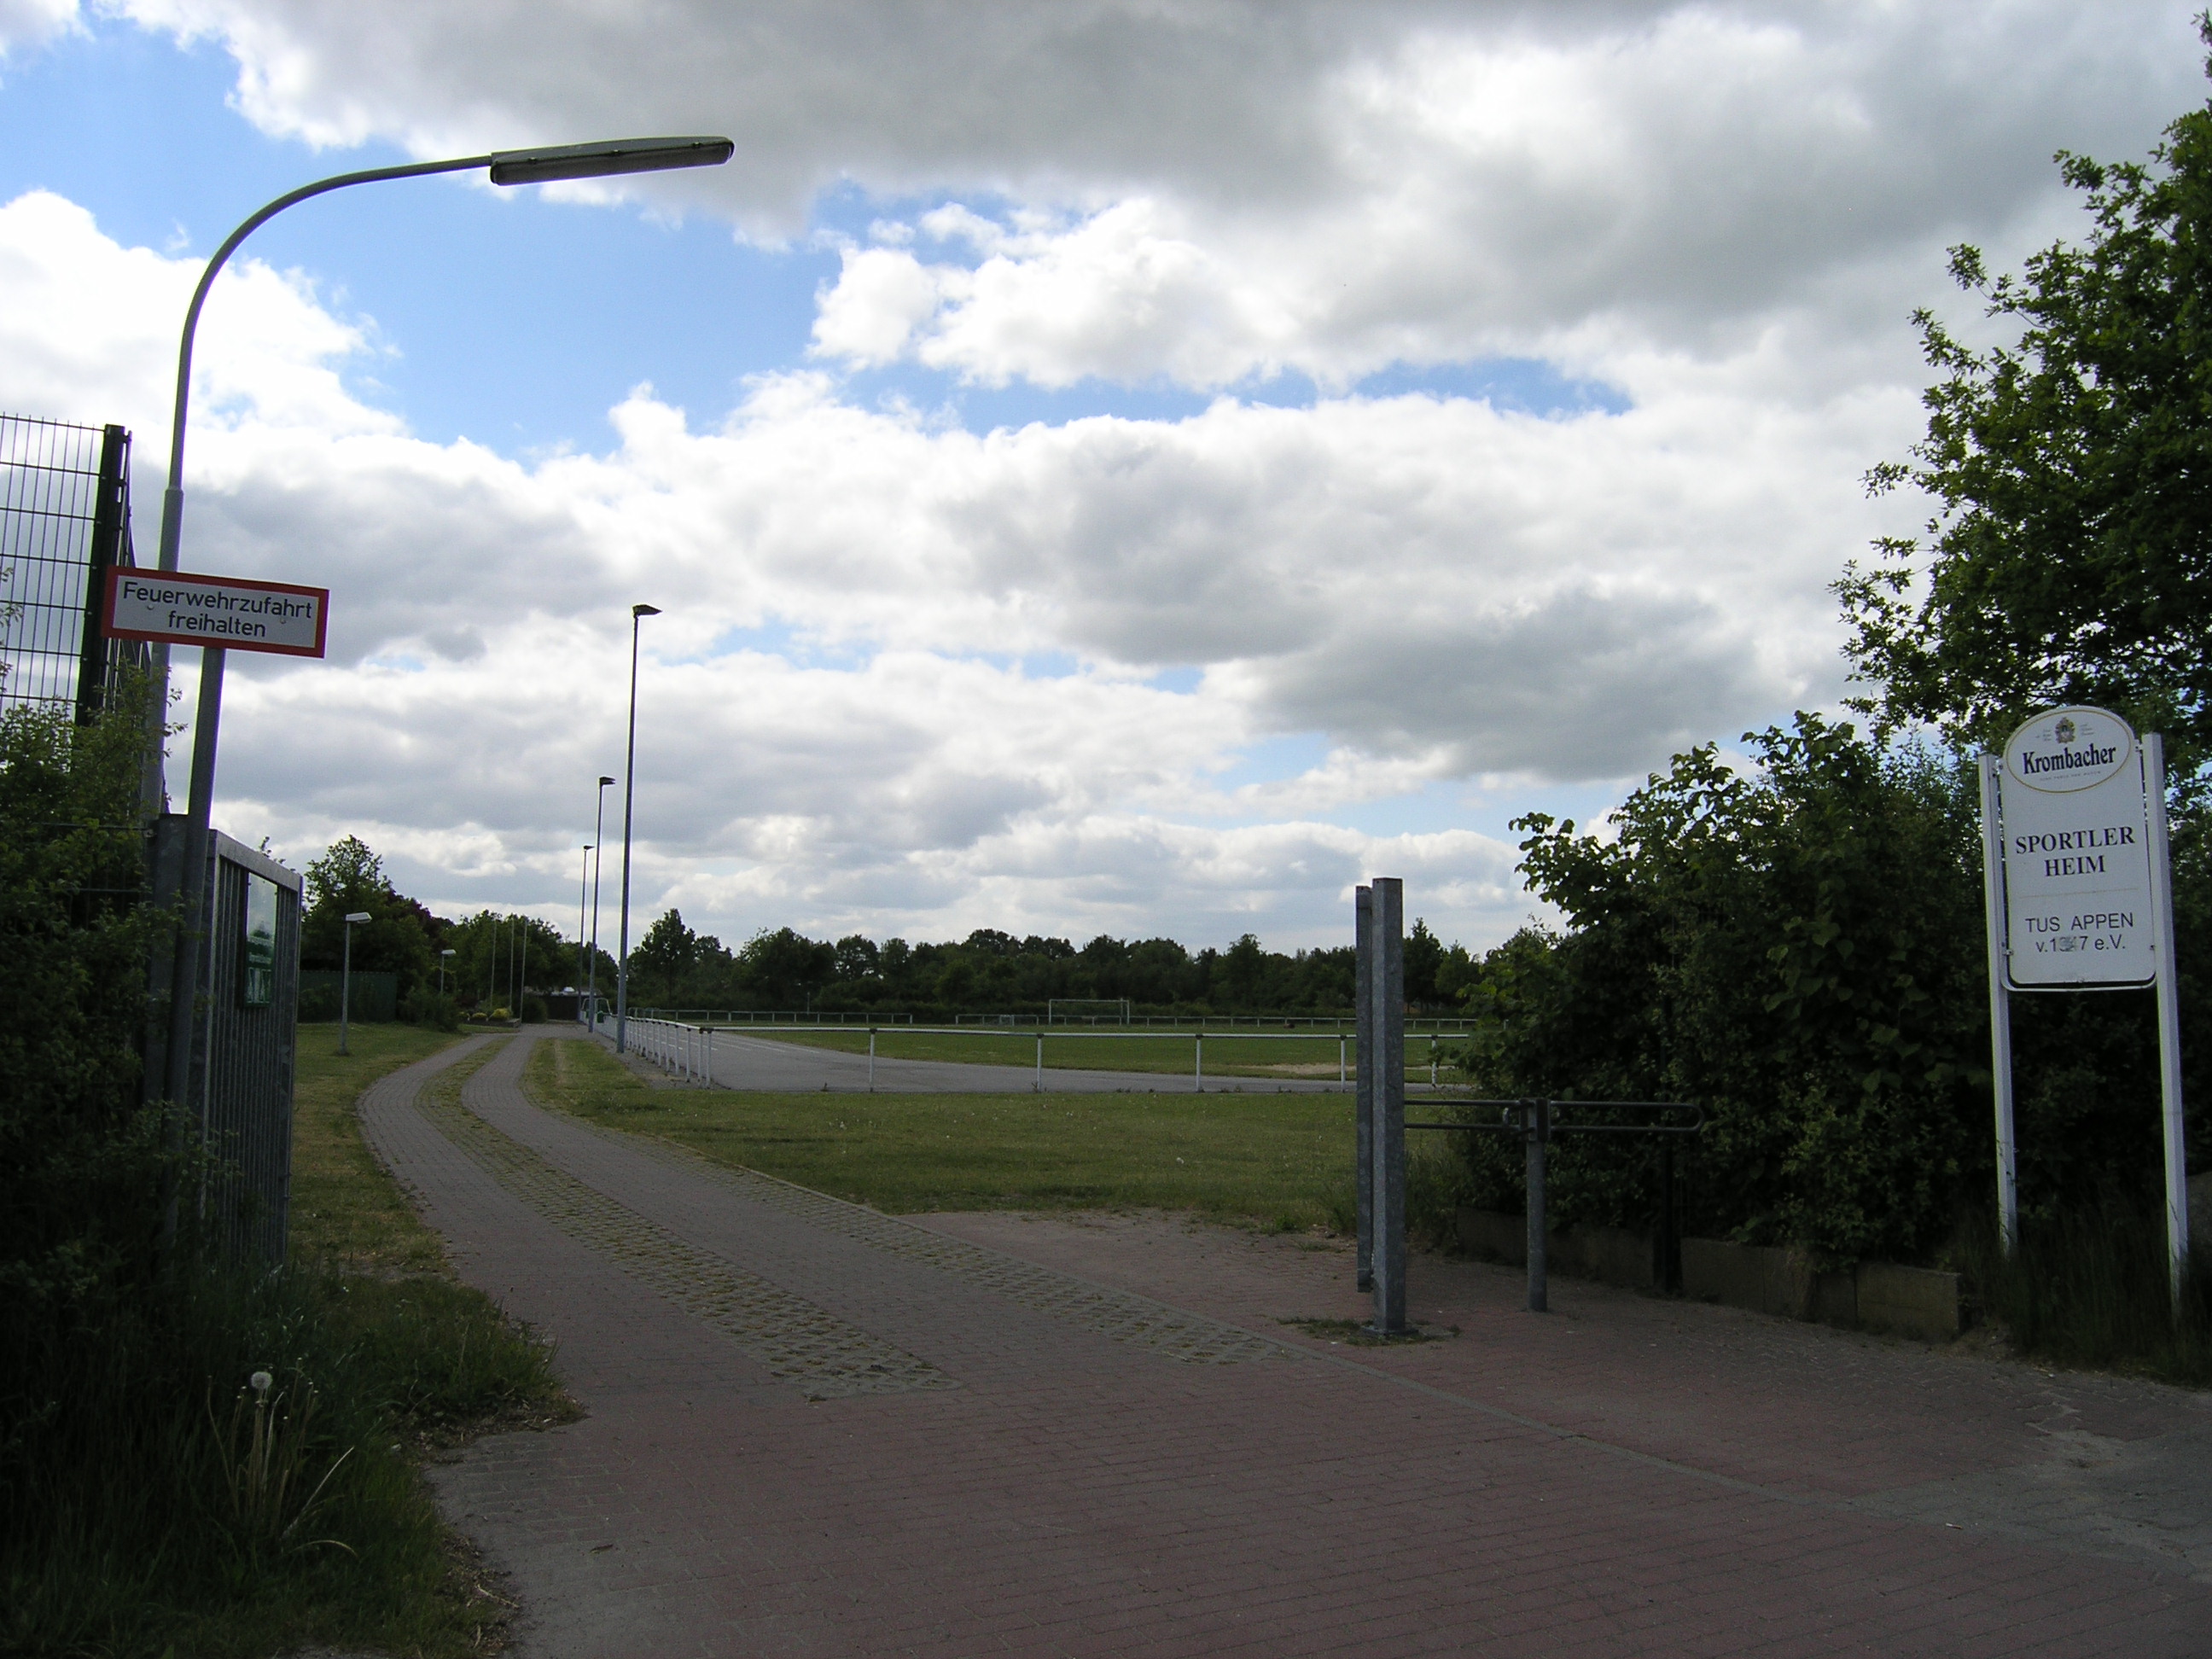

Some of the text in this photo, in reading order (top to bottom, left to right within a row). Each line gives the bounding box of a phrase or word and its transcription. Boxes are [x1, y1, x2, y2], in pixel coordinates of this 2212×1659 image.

[123, 581, 311, 619] Feuerwehrzufahrt
[168, 610, 265, 637] freihalten
[2023, 742, 2116, 775] Krombacher
[2016, 826, 2135, 854] SPORTLER
[2044, 855, 2106, 877] HEIM
[2025, 912, 2133, 933] TUS APPEN
[2094, 934, 2126, 951] e.V.
